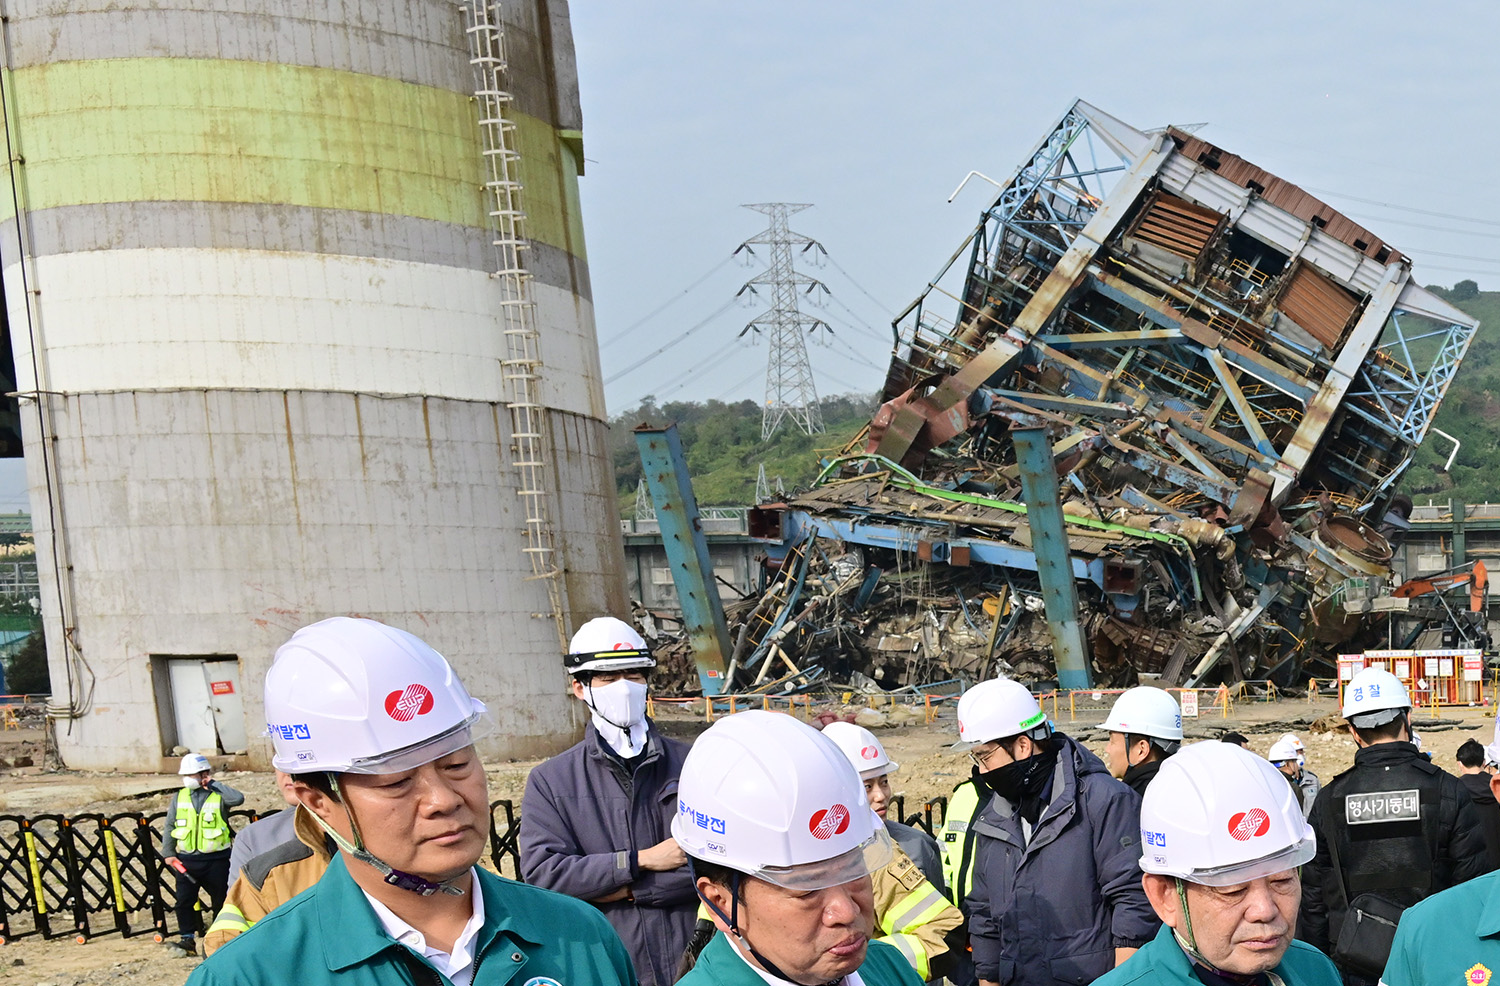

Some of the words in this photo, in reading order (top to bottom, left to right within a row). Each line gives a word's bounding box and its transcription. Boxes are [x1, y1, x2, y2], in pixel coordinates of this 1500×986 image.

[396, 693, 425, 711] EWP
[1353, 684, 1381, 702] 경찰
[1348, 796, 1416, 817] 형사기동대
[818, 813, 844, 829] EWP
[1237, 817, 1264, 831] EWP
